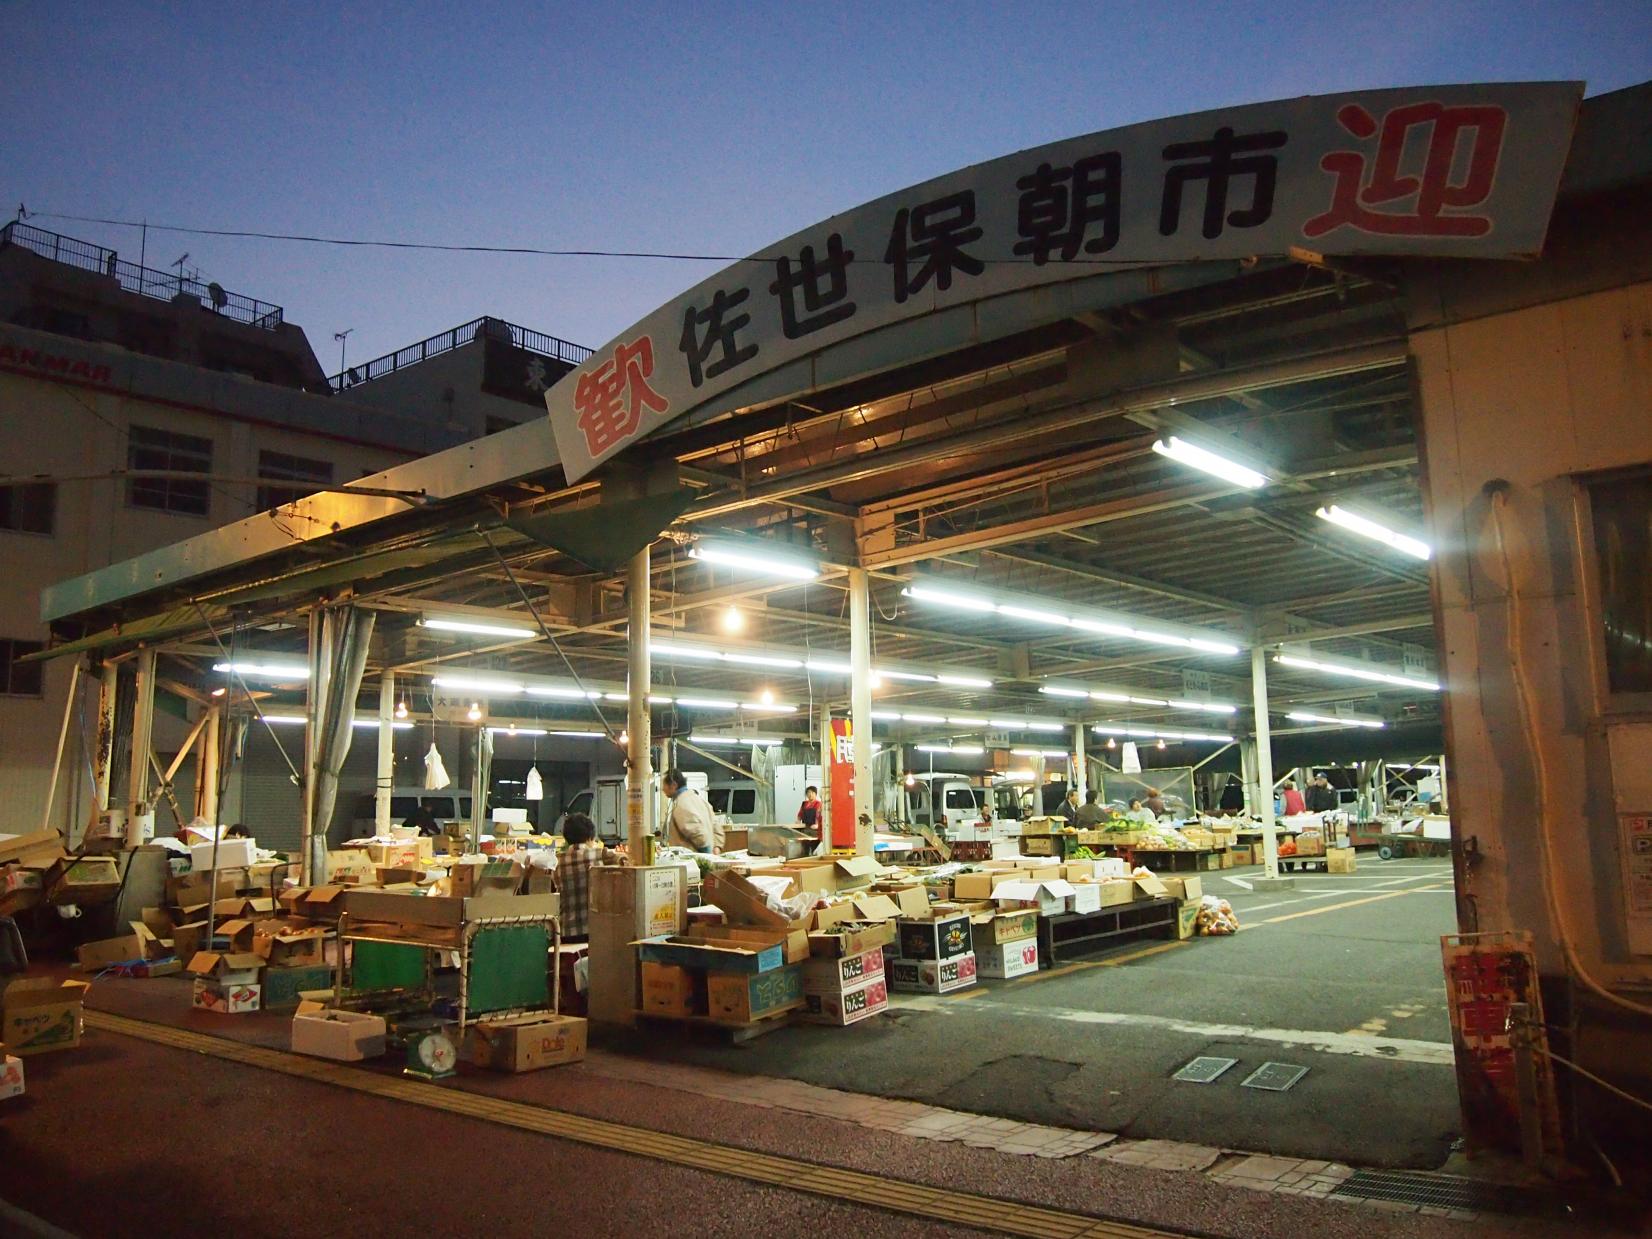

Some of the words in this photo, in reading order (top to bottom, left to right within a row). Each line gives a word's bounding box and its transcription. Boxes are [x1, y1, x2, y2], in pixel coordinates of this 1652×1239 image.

[843, 962, 862, 979] りんご
[846, 996, 865, 1013] りんご
